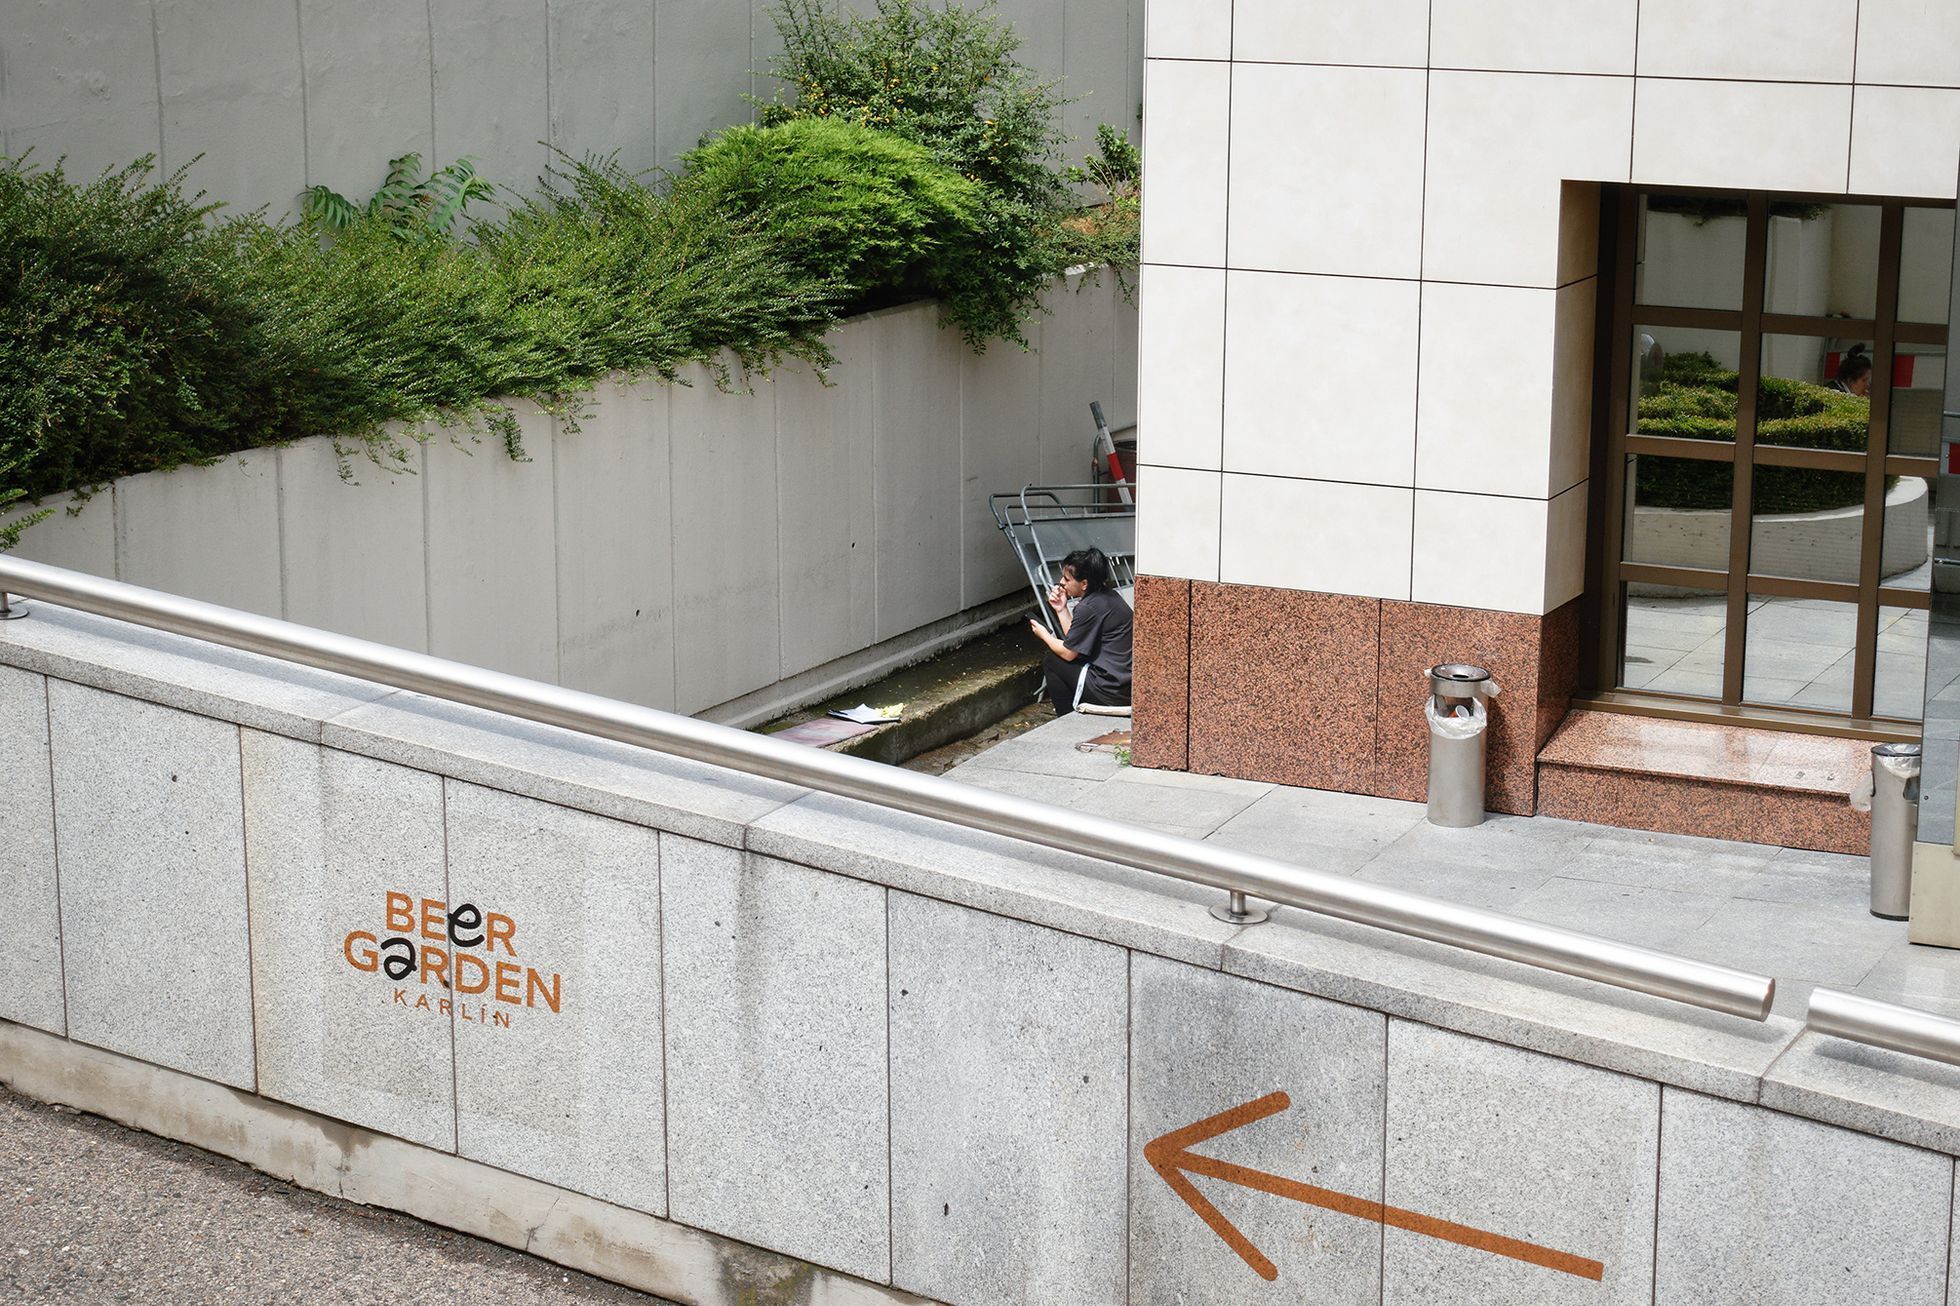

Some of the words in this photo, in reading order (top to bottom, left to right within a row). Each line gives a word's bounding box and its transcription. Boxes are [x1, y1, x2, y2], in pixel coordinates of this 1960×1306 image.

[386, 890, 517, 957] BEeR
[343, 930, 561, 1014] GaRDEN
[394, 988, 509, 1028] KARLÍN
